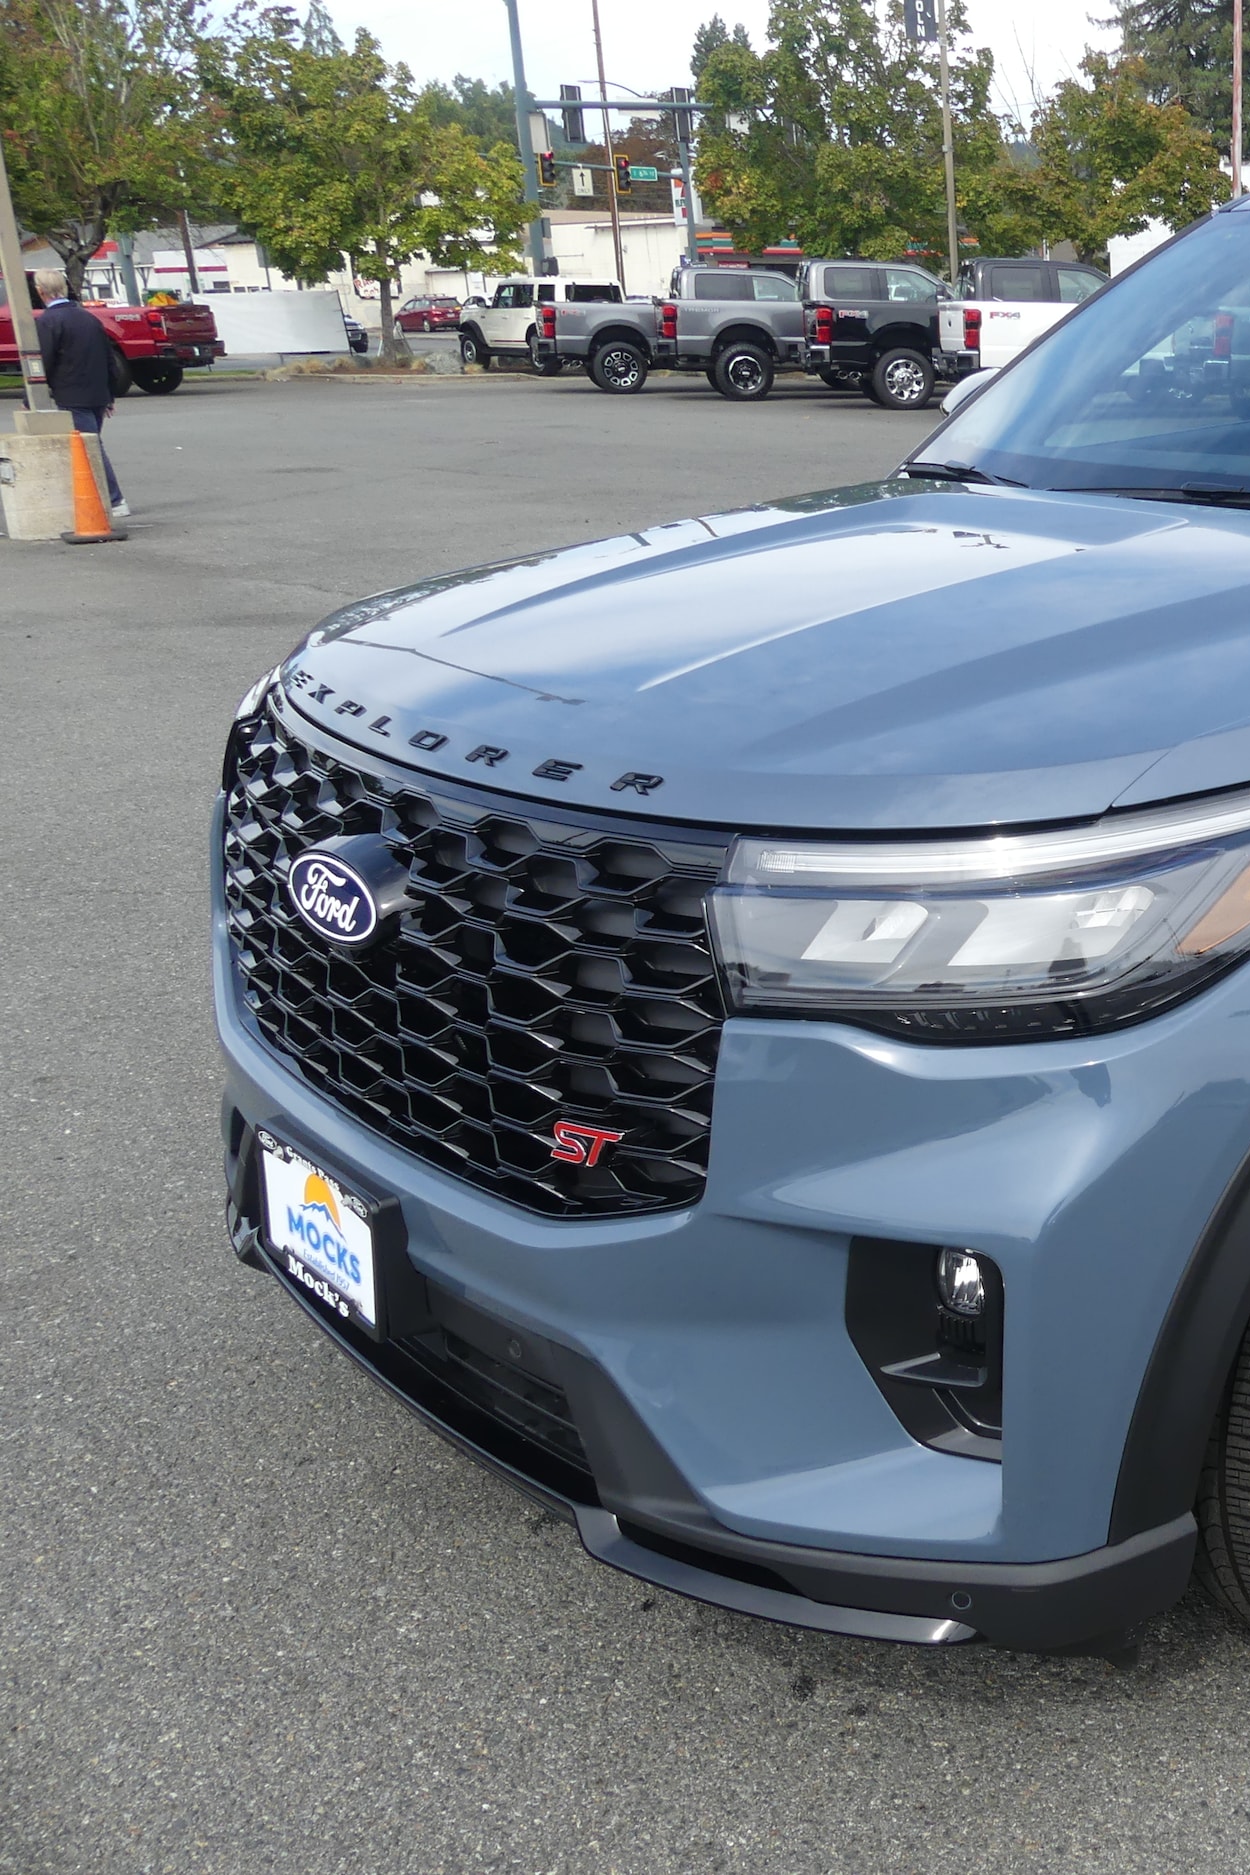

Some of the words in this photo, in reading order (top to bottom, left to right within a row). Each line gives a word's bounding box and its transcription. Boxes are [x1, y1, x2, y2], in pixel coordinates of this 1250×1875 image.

[838, 309, 870, 319] FX4
[989, 311, 1021, 319] FX4
[292, 669, 665, 797] EXPLORER
[301, 862, 360, 932] Ford
[550, 1120, 626, 1167] ST
[287, 1205, 362, 1285] MOCKS
[303, 1248, 336, 1282] Established
[288, 1254, 350, 1318] Mock's
